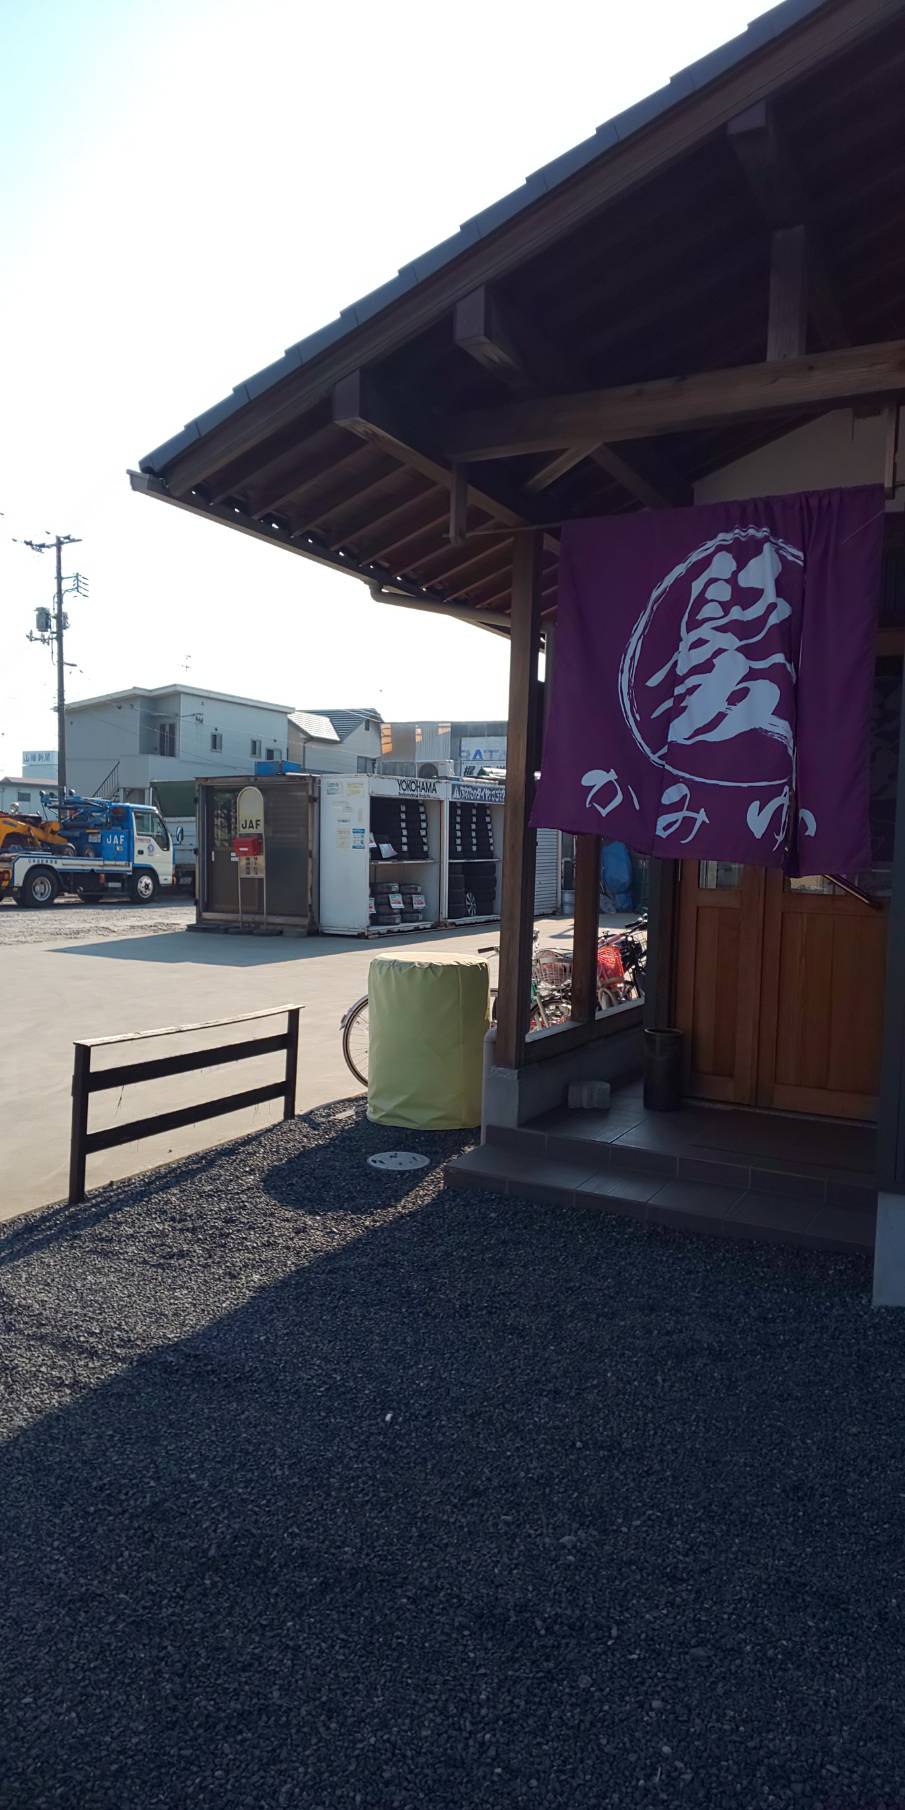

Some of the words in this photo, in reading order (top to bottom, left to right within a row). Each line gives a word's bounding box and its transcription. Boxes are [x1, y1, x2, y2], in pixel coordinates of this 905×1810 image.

[397, 778, 437, 794] YOKOHAMA
[581, 769, 816, 851] かみゆ
[241, 818, 262, 830] JAF
[106, 834, 125, 845] JAF
